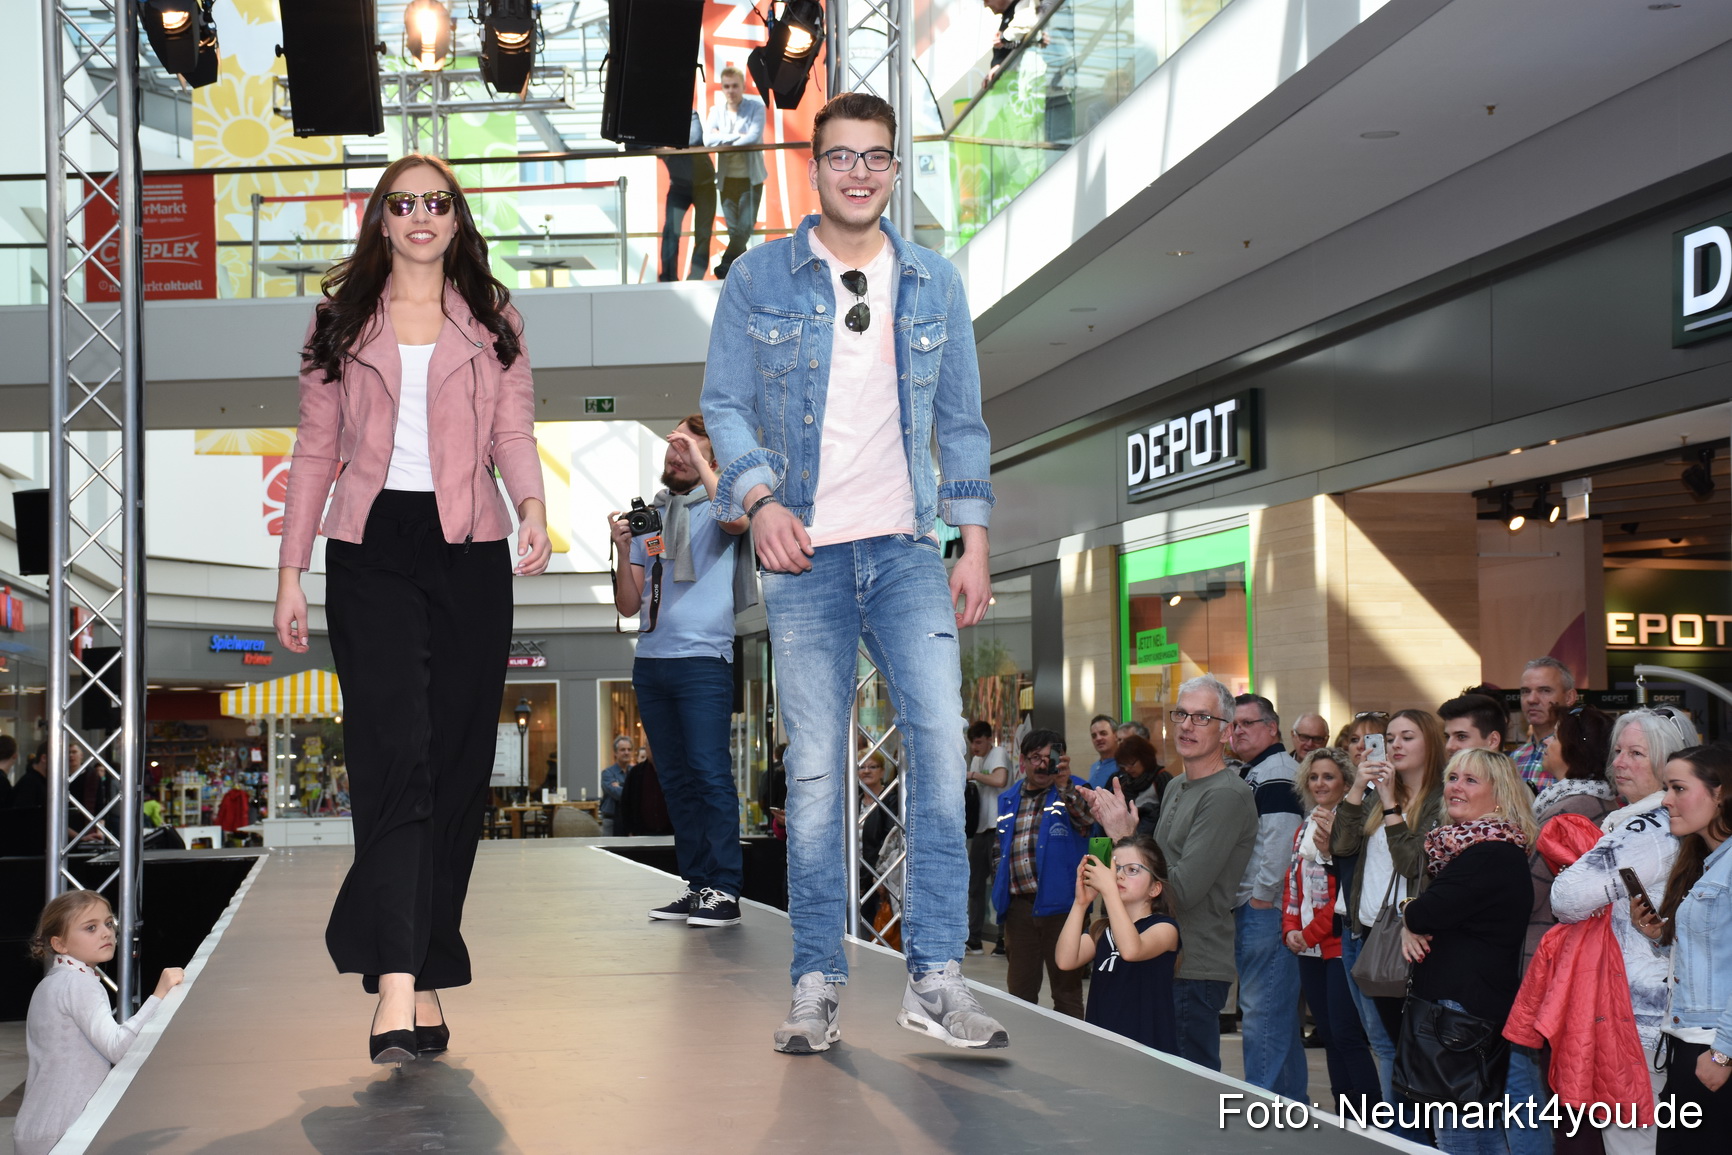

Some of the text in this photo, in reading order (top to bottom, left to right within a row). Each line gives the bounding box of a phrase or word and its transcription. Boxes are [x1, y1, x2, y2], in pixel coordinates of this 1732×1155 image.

[100, 241, 199, 263] CEPLEX
[1127, 399, 1236, 486] DEPOT
[1606, 612, 1732, 646] EPOT
[211, 635, 265, 652] Spielwaren
[1601, 694, 1629, 702] DEPOT
[1653, 694, 1681, 702] DEPOT
